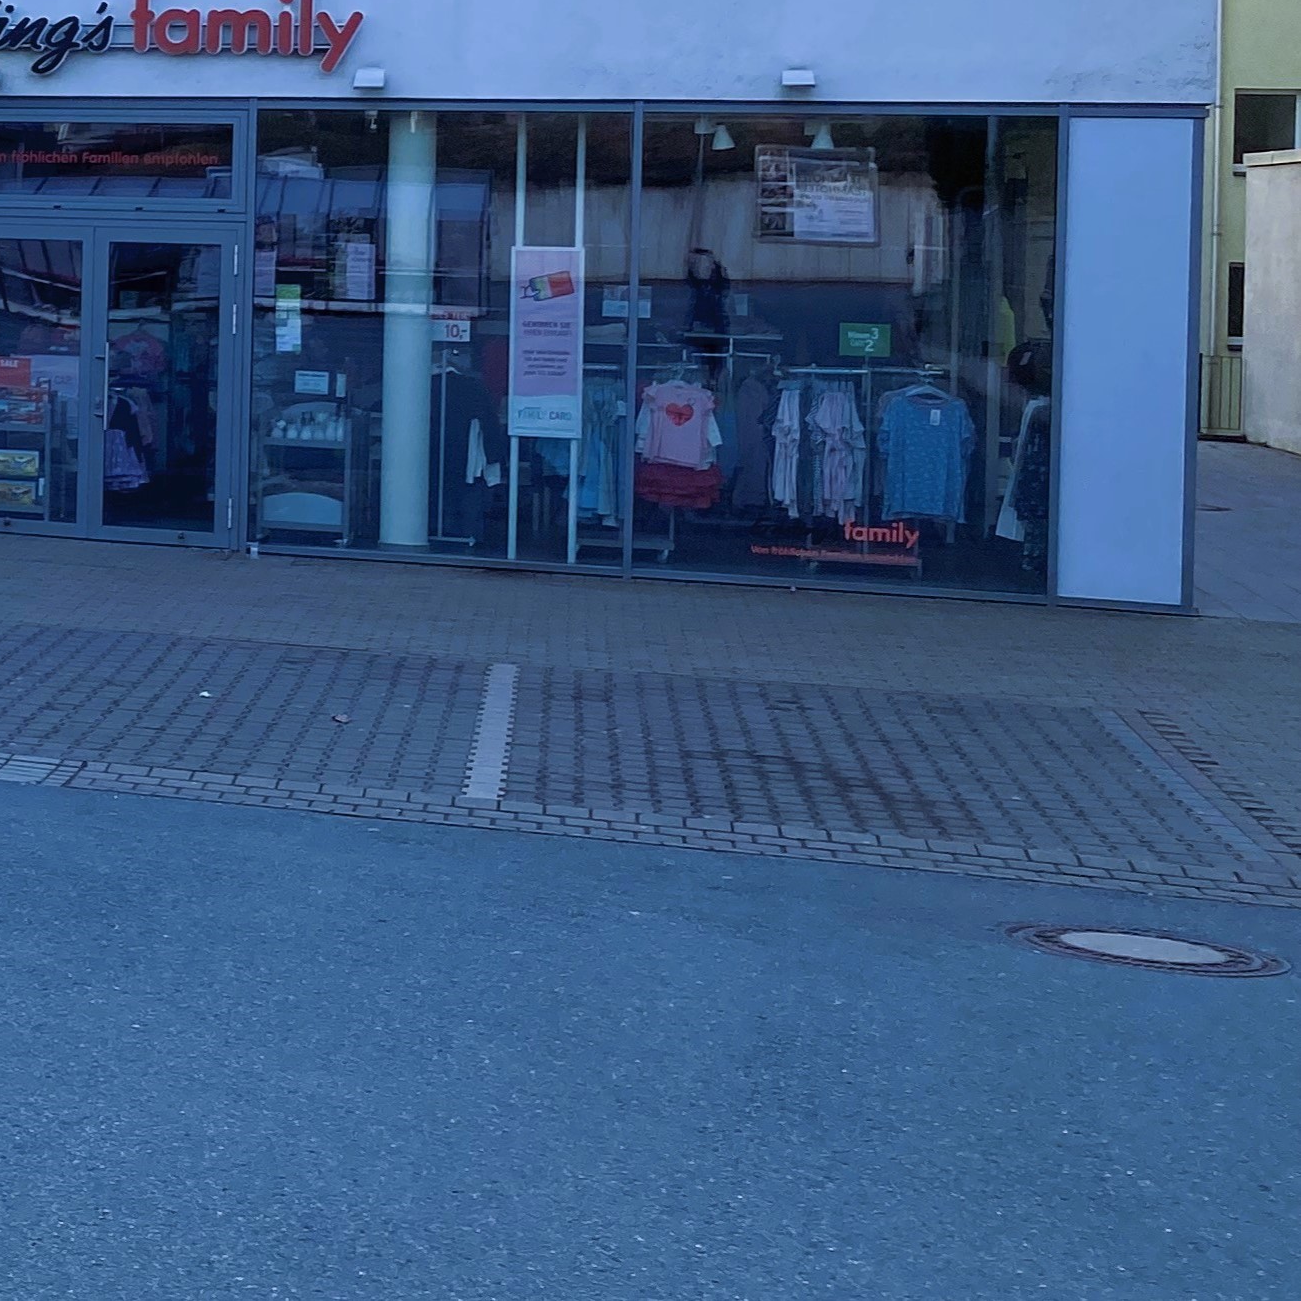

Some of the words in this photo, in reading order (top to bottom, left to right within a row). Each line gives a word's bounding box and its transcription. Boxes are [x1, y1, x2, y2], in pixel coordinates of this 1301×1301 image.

[11, 150, 78, 164] fröhlichen
[82, 151, 139, 164] Familien
[143, 152, 219, 166] empfohlen
[0, 359, 19, 368] SALE
[843, 520, 920, 549] family
